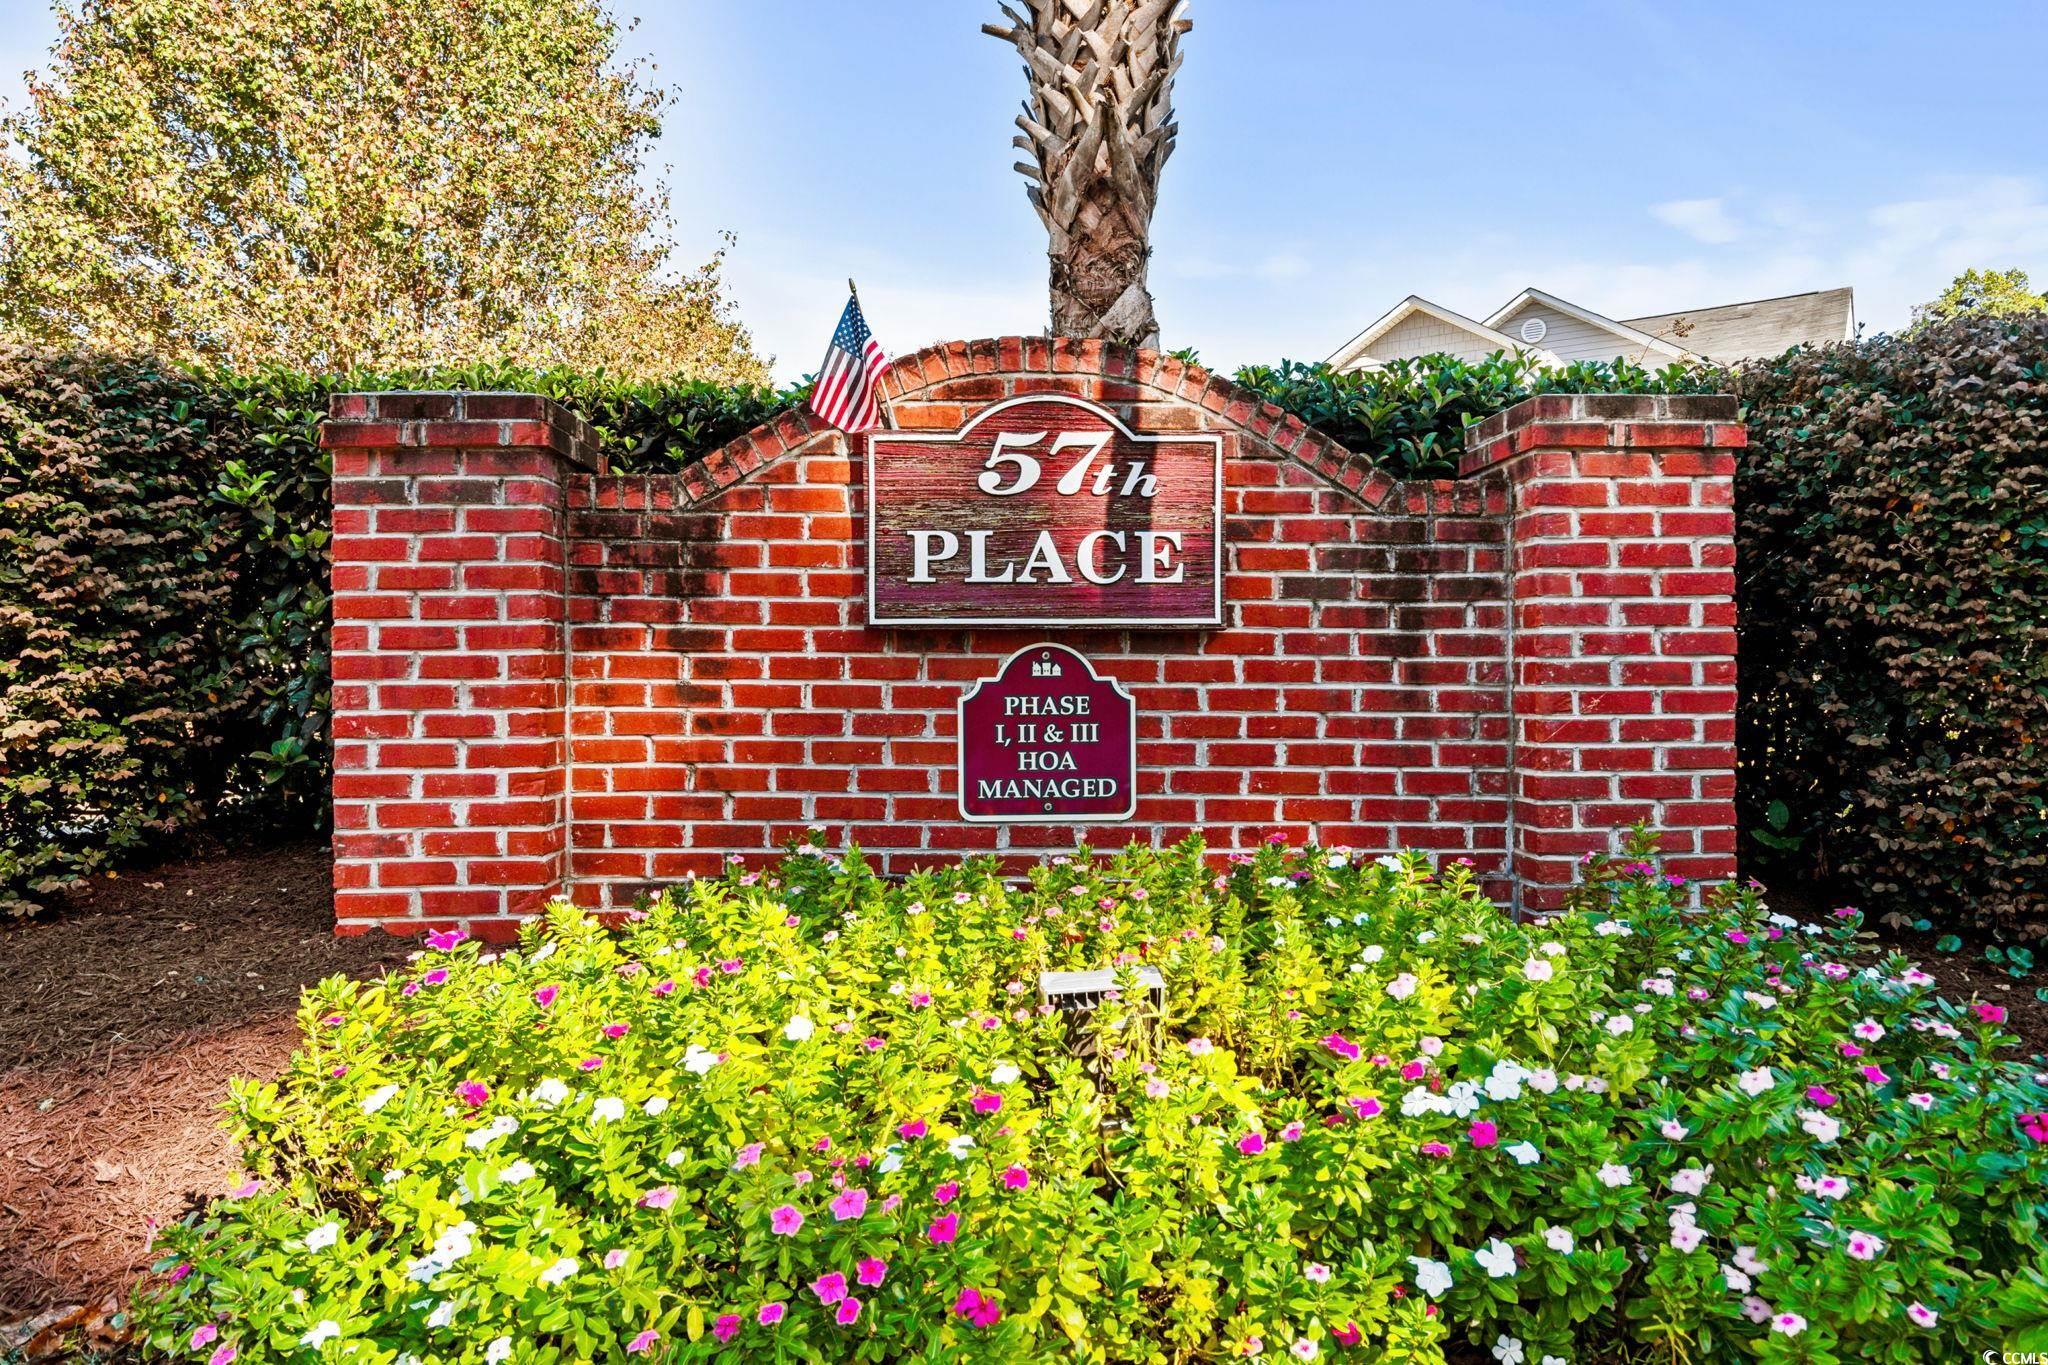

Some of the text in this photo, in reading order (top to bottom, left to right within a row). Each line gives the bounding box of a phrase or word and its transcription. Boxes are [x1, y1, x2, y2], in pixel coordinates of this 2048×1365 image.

[977, 430, 1162, 497] 57th
[906, 530, 1184, 585] PLACE
[1004, 696, 1090, 716] PHASE
[995, 723, 1099, 747] I, II & III
[1017, 751, 1077, 771] HOA
[977, 778, 1117, 799] MANAGED
